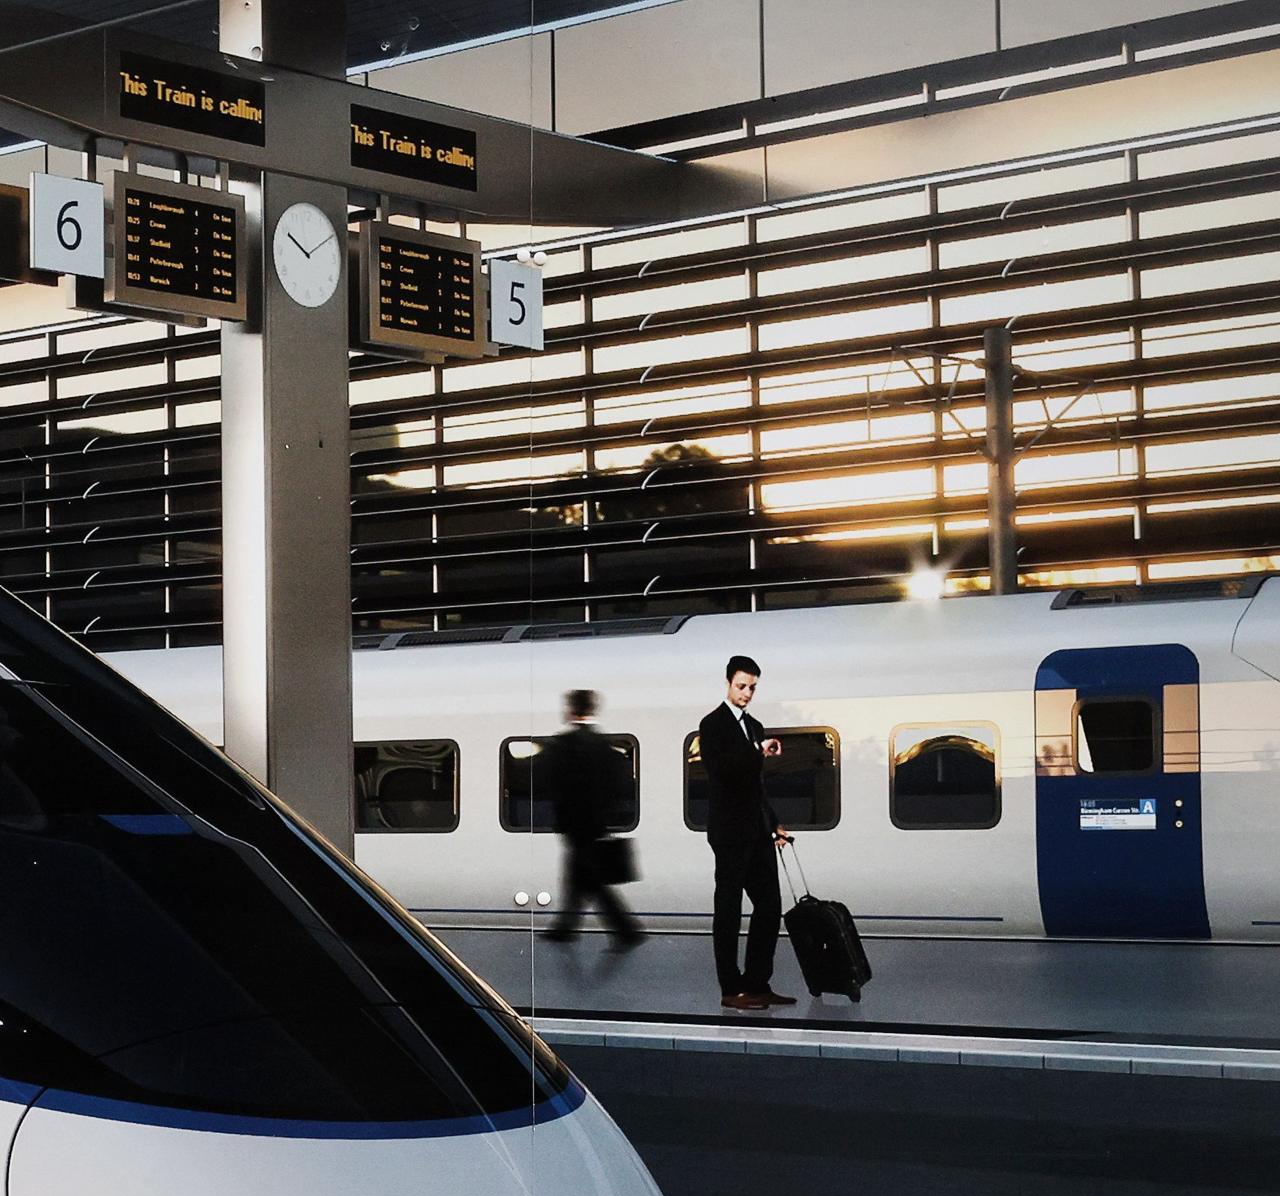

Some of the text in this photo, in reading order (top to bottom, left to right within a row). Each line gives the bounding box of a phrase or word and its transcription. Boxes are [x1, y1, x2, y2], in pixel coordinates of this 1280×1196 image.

[154, 79, 196, 108] Train
[201, 90, 214, 111] is
[379, 130, 416, 156] Train
[420, 139, 432, 159] is
[57, 201, 82, 250] 6
[508, 281, 526, 325] 5
[1080, 806, 1113, 816] Birmingham
[1143, 800, 1154, 813] A
